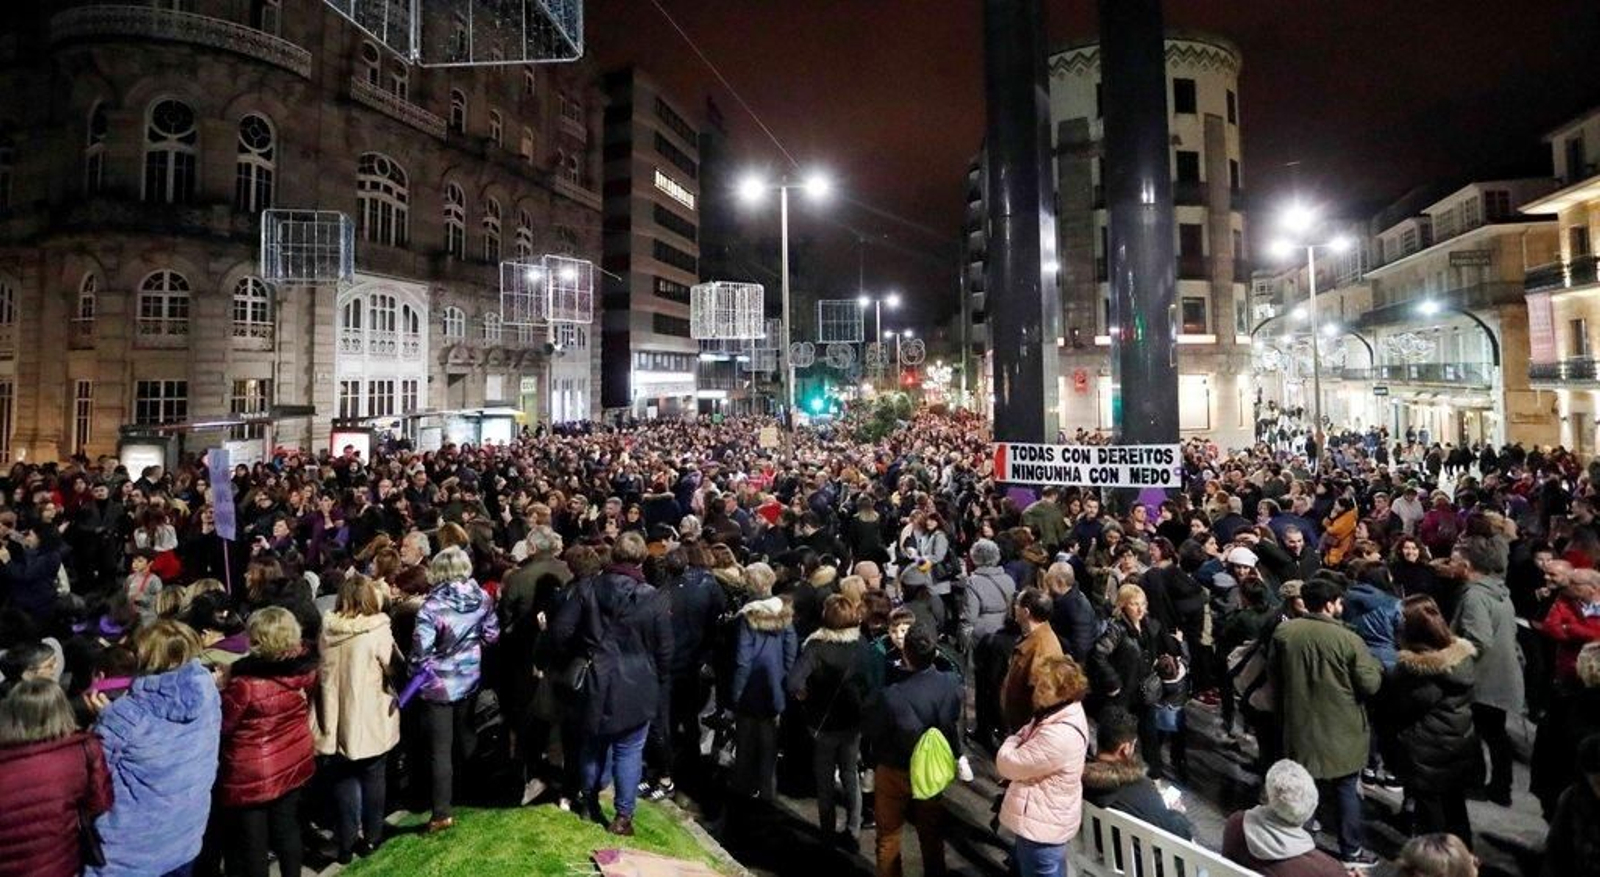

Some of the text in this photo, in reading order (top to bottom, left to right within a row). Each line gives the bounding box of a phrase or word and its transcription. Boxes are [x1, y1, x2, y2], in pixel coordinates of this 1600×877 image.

[1011, 446, 1173, 464] TODAS CON DEREITOS
[1011, 464, 1171, 485] NINGUNHA CON MEDO
